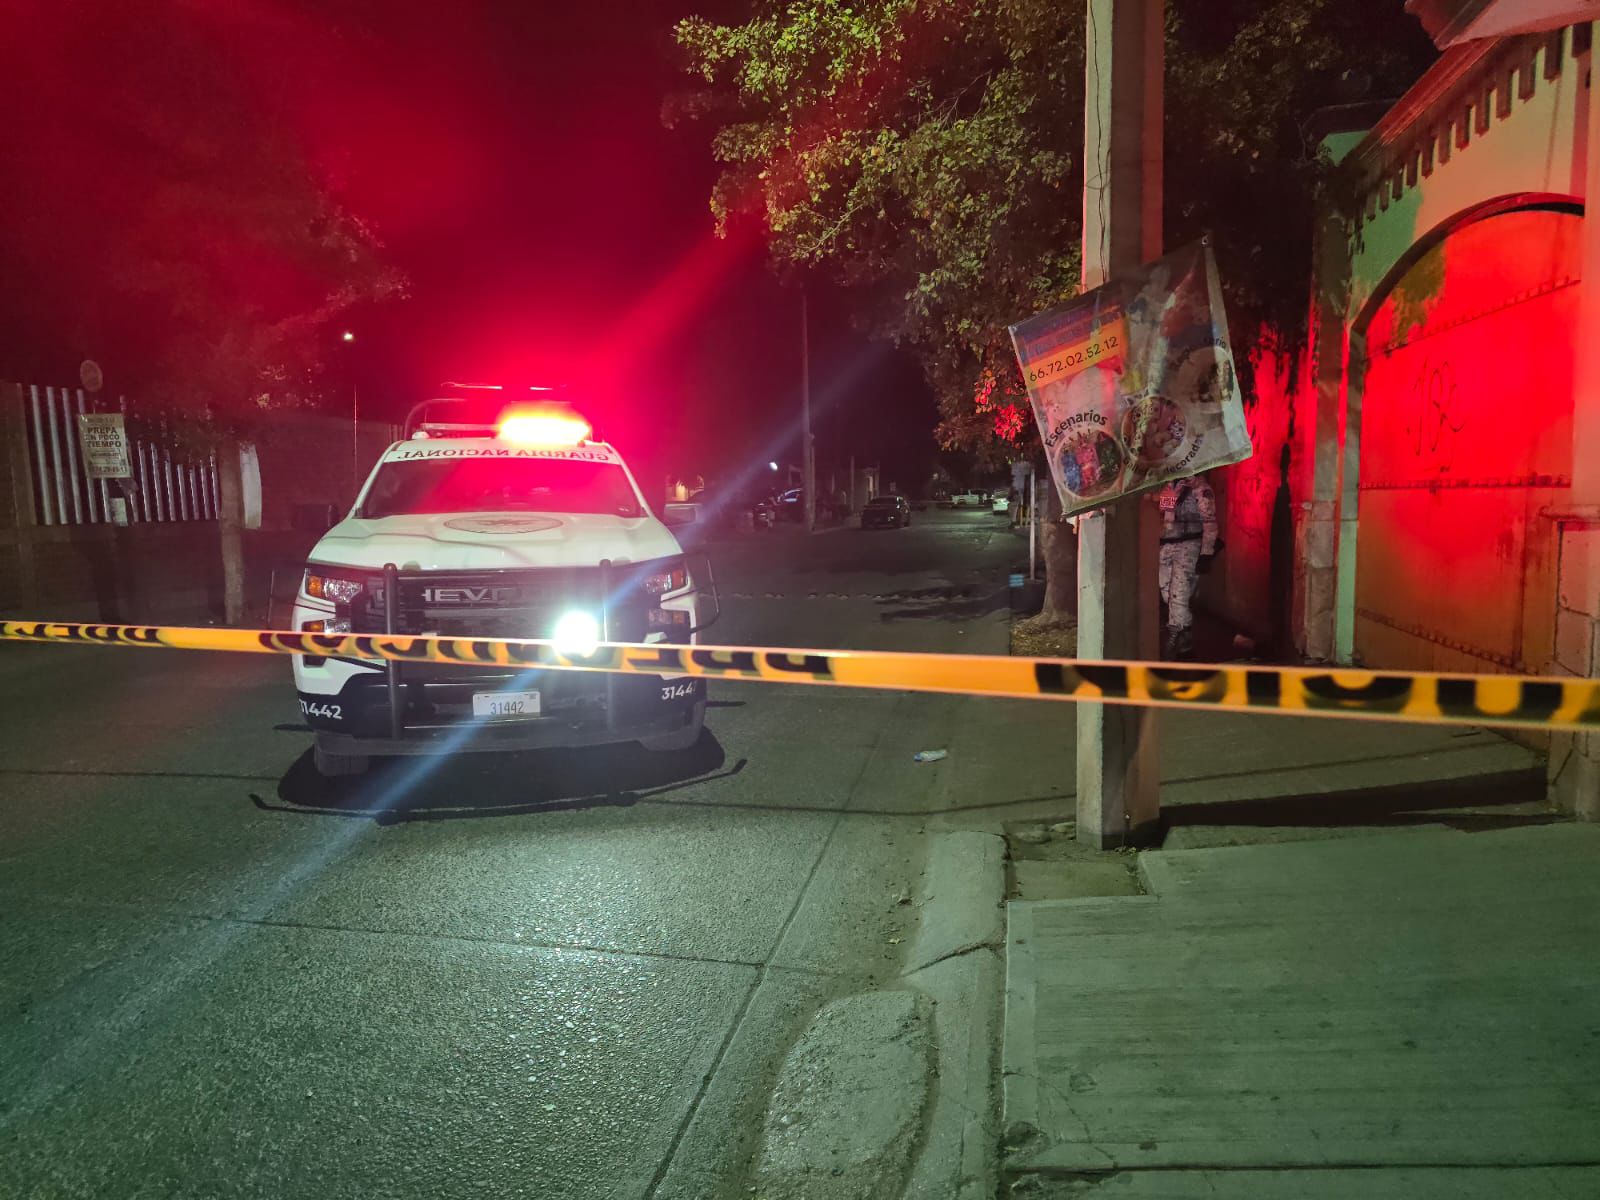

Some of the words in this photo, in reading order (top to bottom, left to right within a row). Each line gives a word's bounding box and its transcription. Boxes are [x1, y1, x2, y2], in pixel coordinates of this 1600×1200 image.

[1029, 336, 1119, 382] 66.72.02.52.12
[87, 426, 117, 434] PREPA
[1045, 409, 1108, 448] Escenarios
[86, 440, 121, 448] TIEMPO
[661, 680, 697, 700] 3144
[489, 700, 525, 714] 31442
